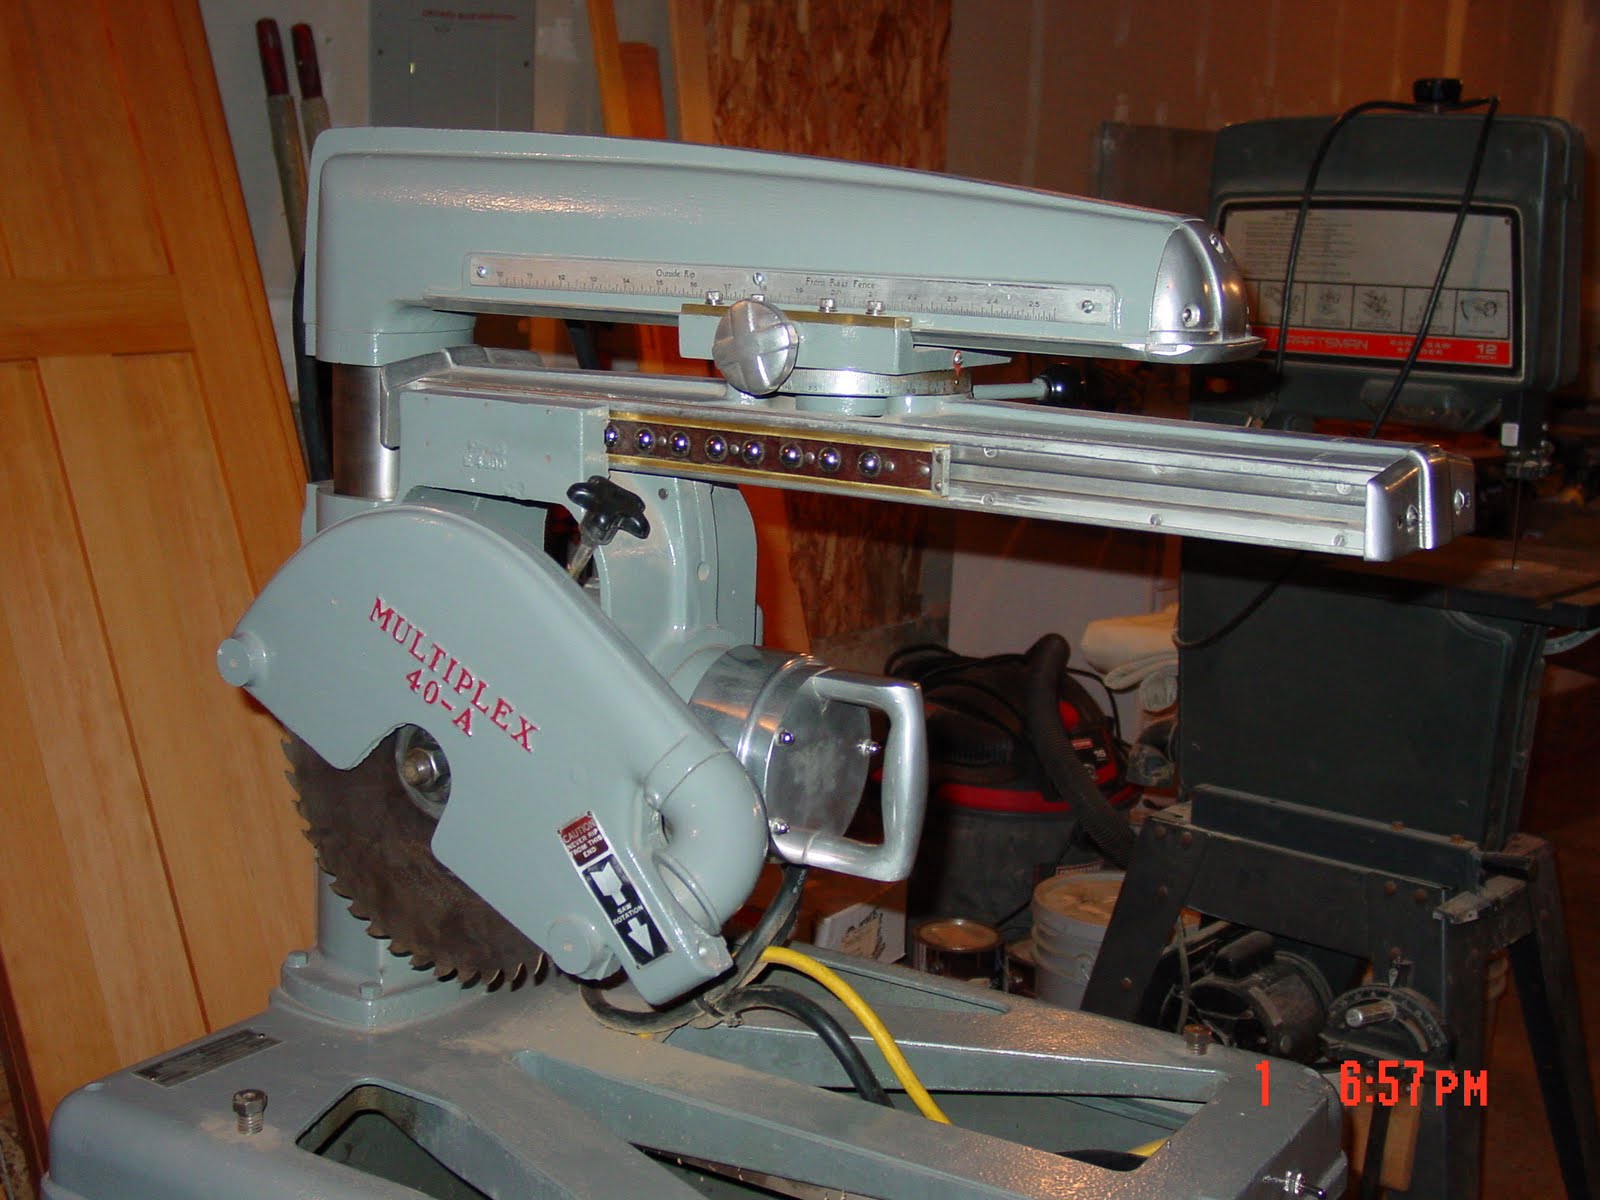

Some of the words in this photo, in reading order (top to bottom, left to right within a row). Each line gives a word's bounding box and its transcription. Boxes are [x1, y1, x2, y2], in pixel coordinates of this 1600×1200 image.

[684, 269, 696, 279] Rip
[805, 276, 825, 287] From
[829, 278, 849, 288] Rear
[853, 279, 876, 289] Fence
[1476, 343, 1498, 355] 12
[368, 596, 541, 753] MULTIPLEX
[405, 668, 475, 737] 40-A
[562, 819, 597, 844] CAUTION
[566, 834, 588, 851] NEVER
[587, 828, 599, 839] RIP
[587, 834, 603, 846] THIS
[582, 846, 597, 859] END
[612, 904, 644, 926] ROTATION
[617, 902, 633, 915] SAW
